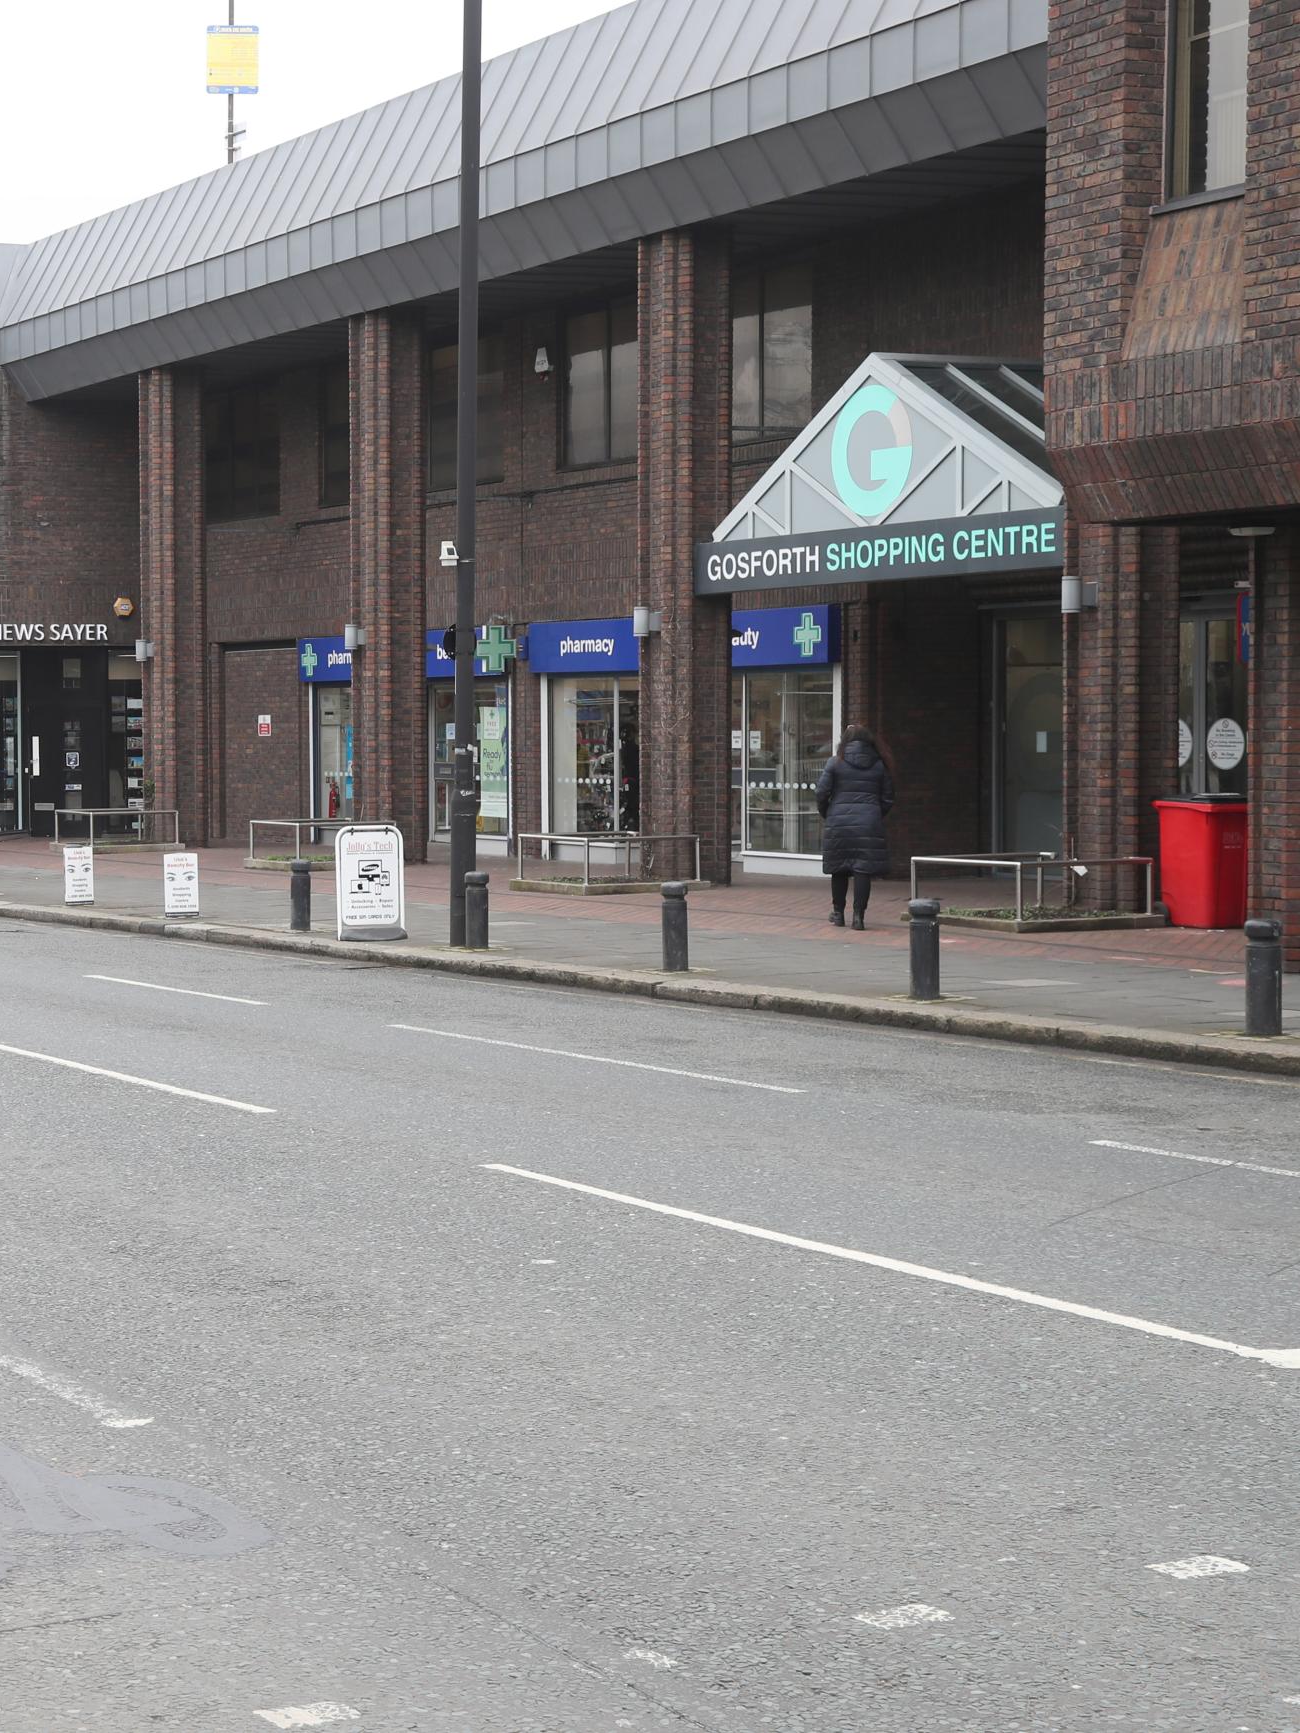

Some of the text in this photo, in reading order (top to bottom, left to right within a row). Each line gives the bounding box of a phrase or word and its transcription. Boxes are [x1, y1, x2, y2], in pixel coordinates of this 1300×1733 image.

[831, 384, 913, 517] G
[707, 522, 1056, 581] GOSFORTH SHOPPING CENTRE
[49, 623, 109, 641] SAYER
[731, 627, 760, 650] auty
[560, 635, 615, 656] pharmacy
[327, 649, 352, 667] pharm
[483, 748, 501, 761] Ready
[347, 840, 393, 852] Jolly's Tech
